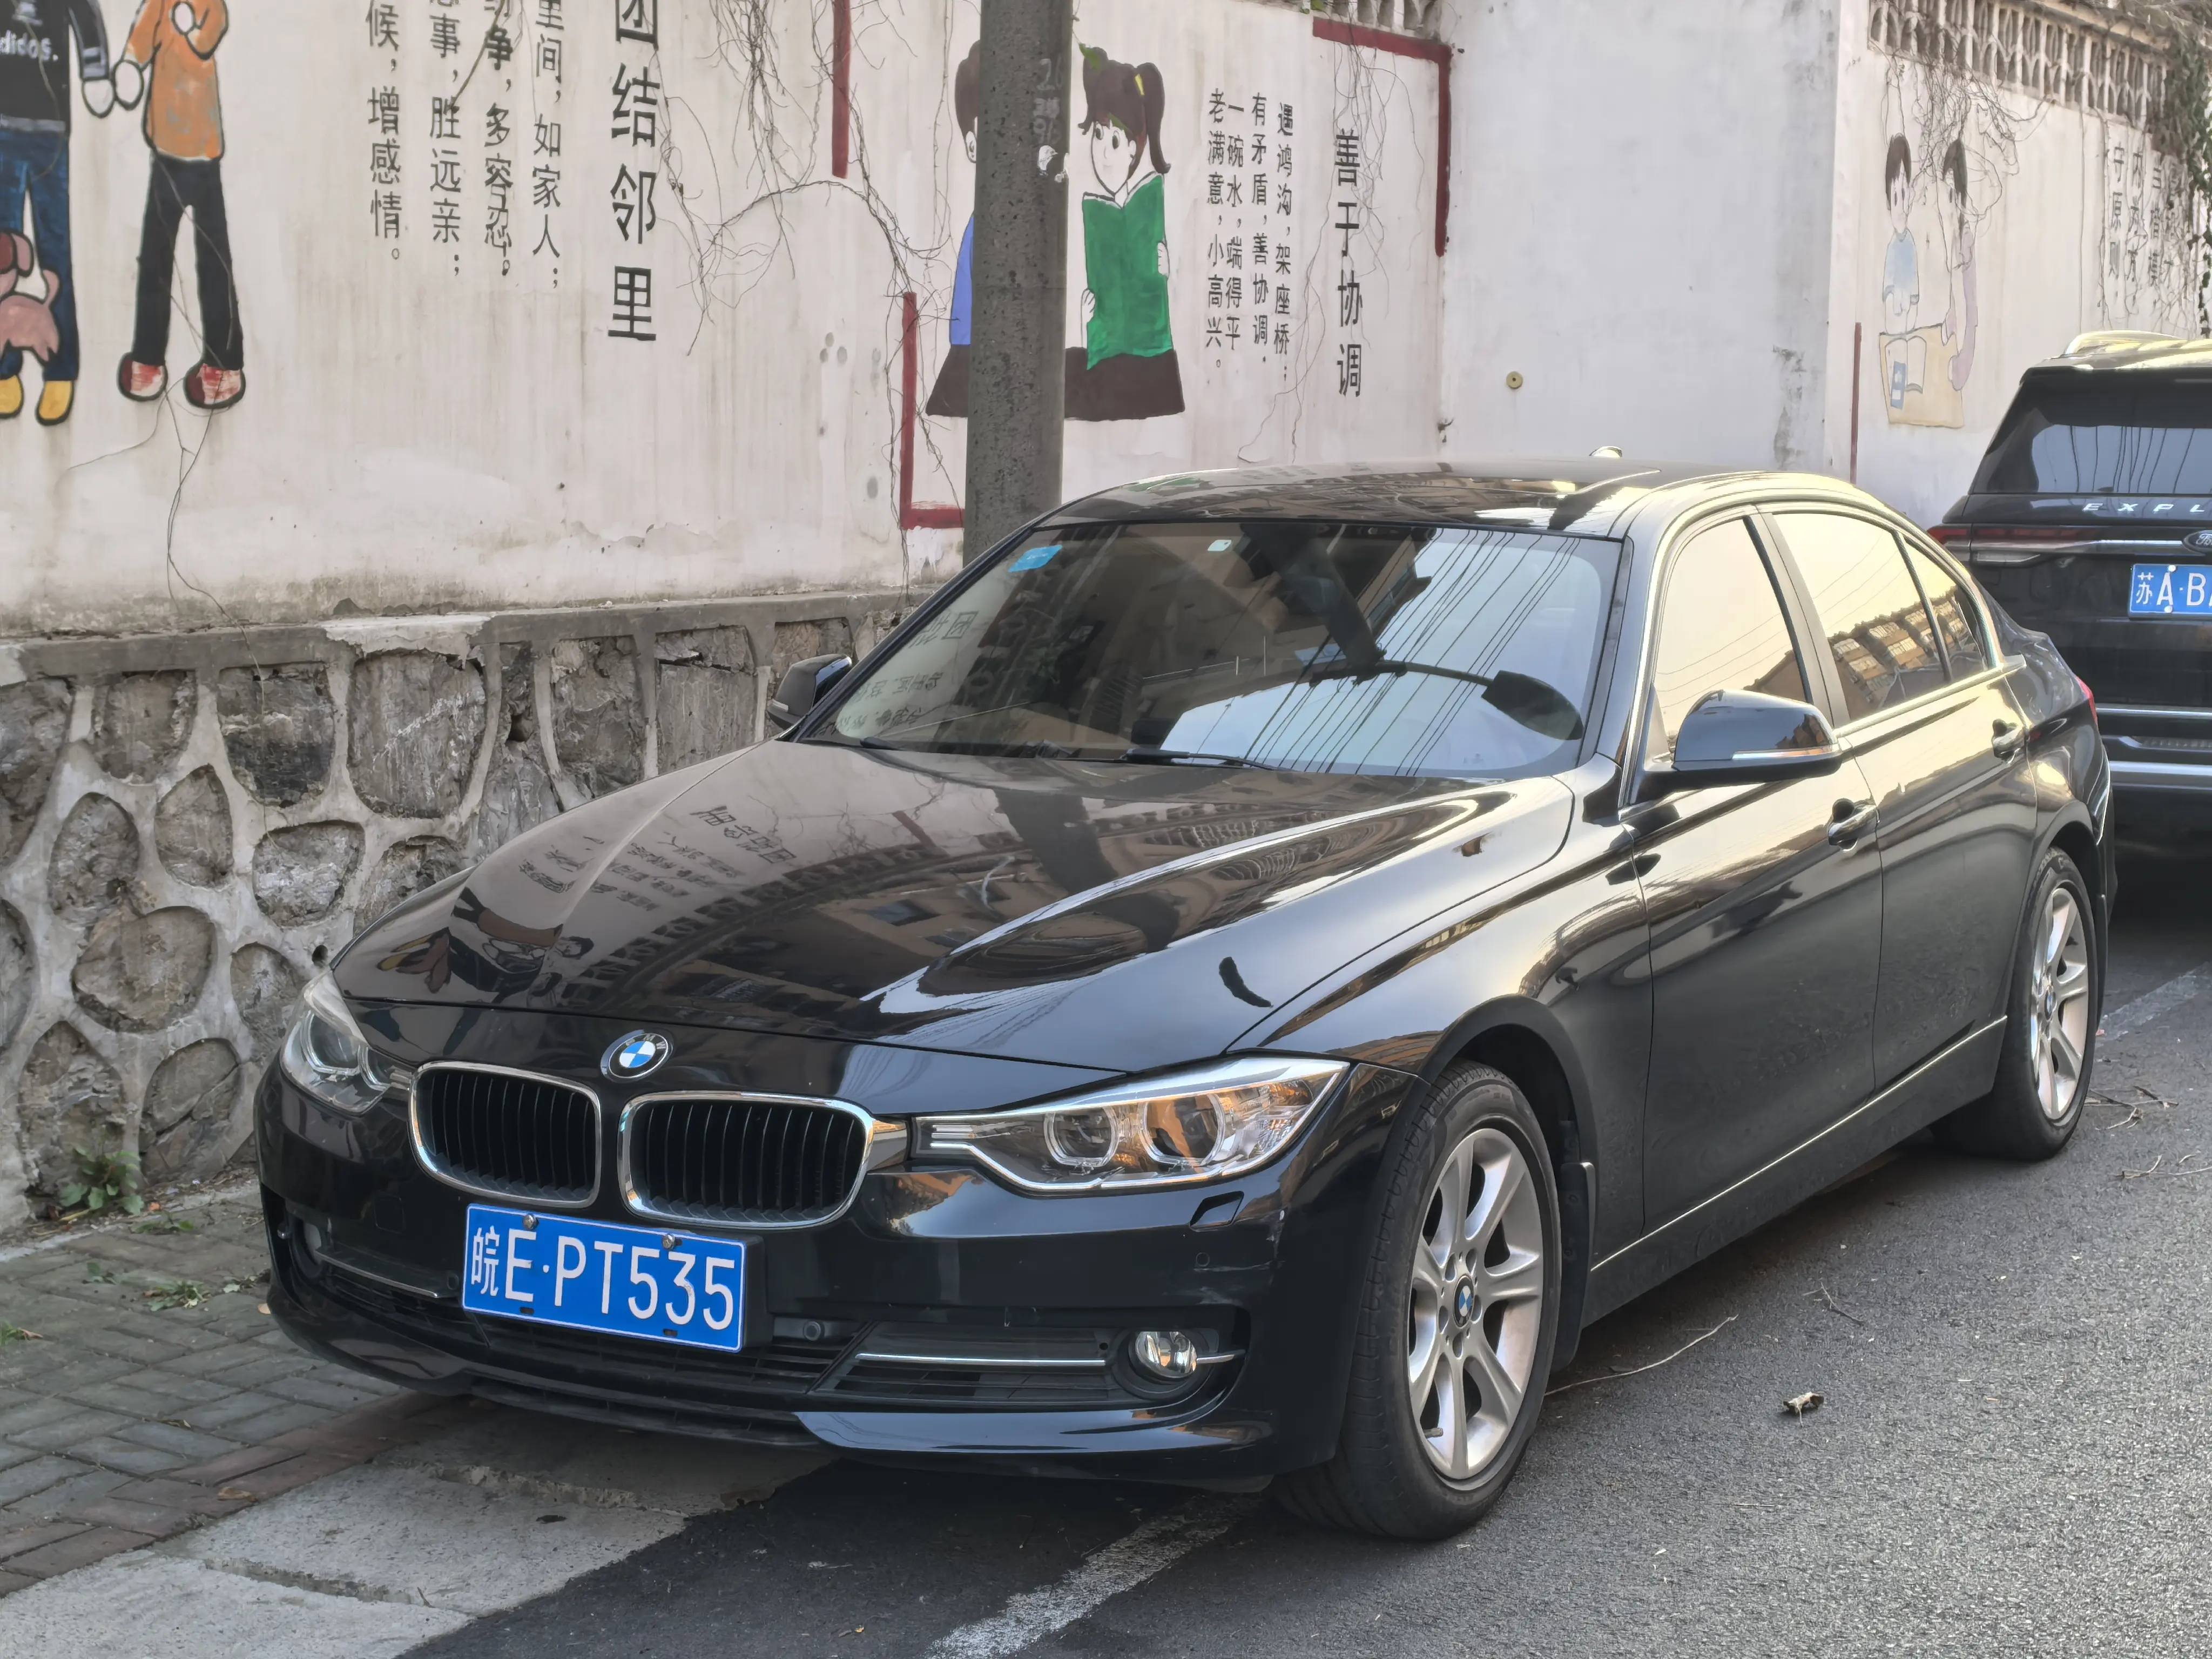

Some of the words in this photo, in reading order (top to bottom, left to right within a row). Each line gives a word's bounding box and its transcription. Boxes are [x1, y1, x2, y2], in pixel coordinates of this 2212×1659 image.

[429, 0, 461, 276] 事，胜远亲；
[608, 0, 660, 341] 团结邻里
[1334, 129, 1363, 397] 善于协调
[2136, 572, 2212, 608] 苏A·B
